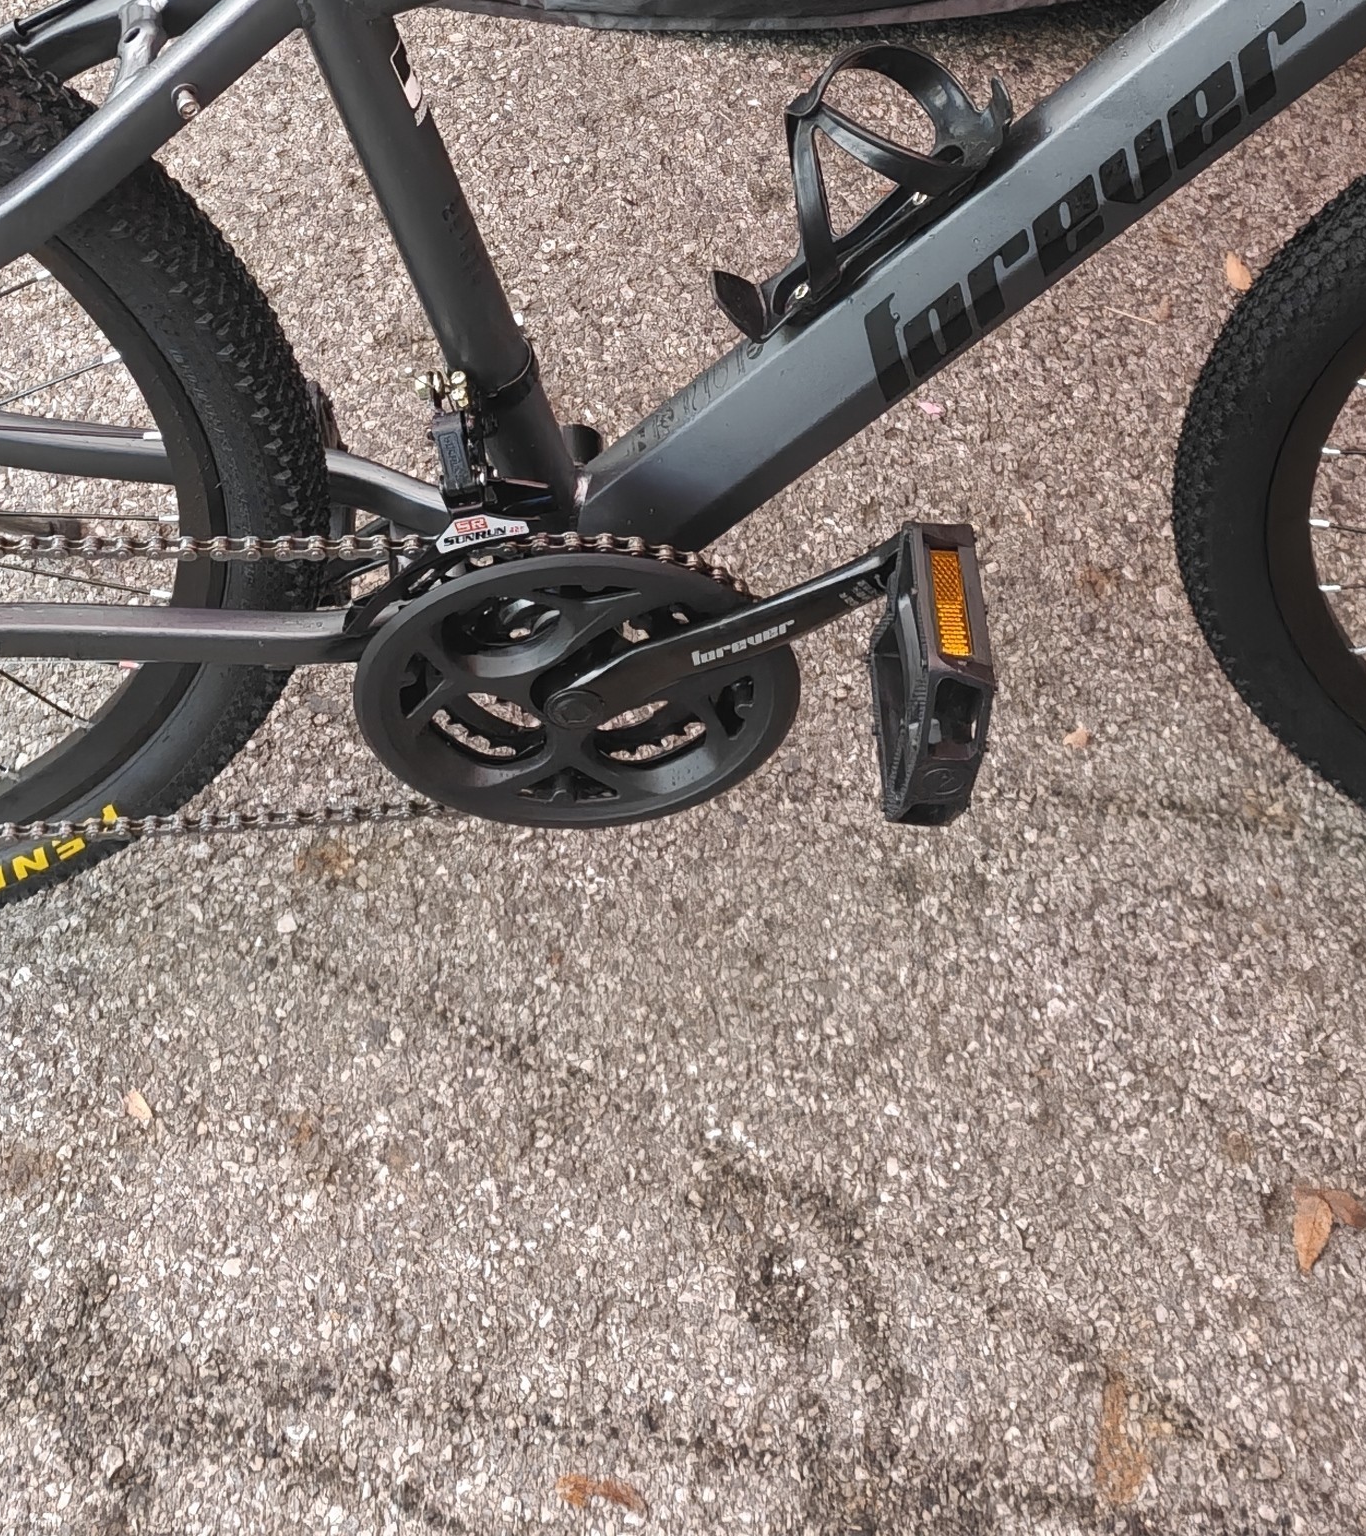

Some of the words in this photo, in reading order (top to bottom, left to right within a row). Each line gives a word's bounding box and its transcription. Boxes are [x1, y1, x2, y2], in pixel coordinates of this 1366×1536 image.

[863, 0, 1307, 384] forever
[455, 517, 489, 534] SR
[691, 619, 796, 666] forever
